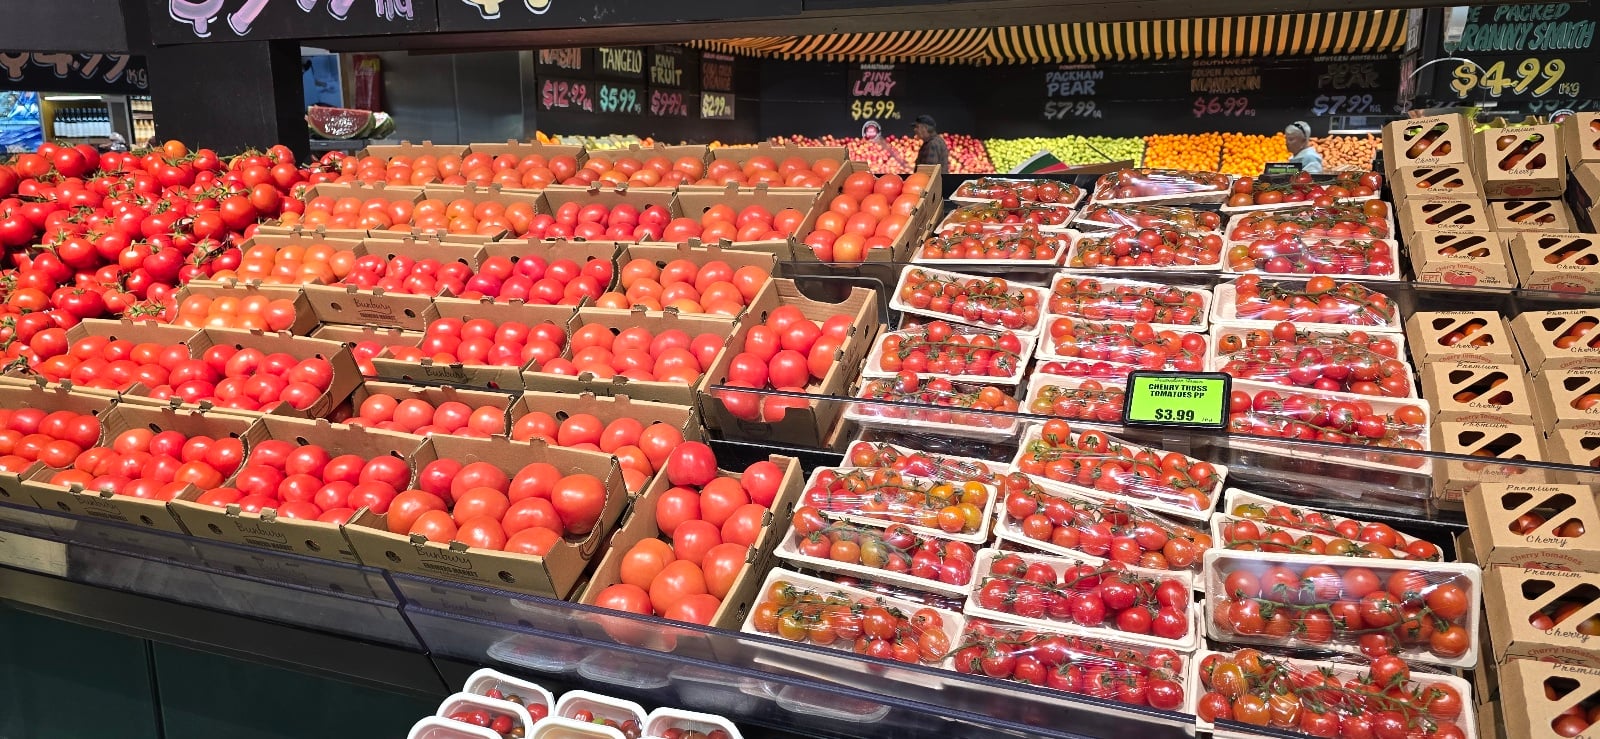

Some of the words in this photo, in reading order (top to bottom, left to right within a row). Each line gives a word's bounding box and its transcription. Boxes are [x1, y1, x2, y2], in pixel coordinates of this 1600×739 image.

[1493, 3, 1571, 23] PACKED
[1444, 22, 1535, 53] RANNY
[1527, 19, 1597, 51] SMITH
[599, 46, 643, 74] TANGELO
[655, 53, 675, 70] KIWI
[650, 66, 683, 87] FRUIT
[862, 70, 893, 82] PINK
[1045, 70, 1104, 83] PACKHAM
[1449, 57, 1566, 98] $4.99
[542, 79, 587, 110] $12.99
[852, 80, 897, 97] LADY
[1046, 80, 1097, 98] PEAR
[599, 84, 636, 113] $5.99
[1310, 94, 1374, 117] $7.99
[851, 99, 896, 121] $5.99
[1043, 100, 1096, 120] $7.99
[1192, 96, 1249, 118] $6.99
[1414, 157, 1441, 166] Cherry
[1508, 169, 1535, 177] Cherry
[1556, 264, 1587, 272] Cherry
[1456, 361, 1500, 370] Premium
[1148, 383, 1180, 391] CHERRY
[1181, 384, 1208, 392] TRUSS
[1150, 390, 1193, 398] TOMATOES
[1193, 391, 1205, 399] PP
[1469, 402, 1502, 411] Cherry
[1154, 408, 1195, 422] $3.99
[1505, 484, 1560, 492] Premium
[1526, 535, 1568, 548] Cherry
[415, 545, 473, 570] Bunbury
[1510, 552, 1540, 563] Cherry
[1541, 550, 1583, 566] Tomatoes
[1524, 568, 1583, 579] Premium
[1544, 627, 1591, 643] Cherry
[1527, 647, 1560, 656] Cherry
